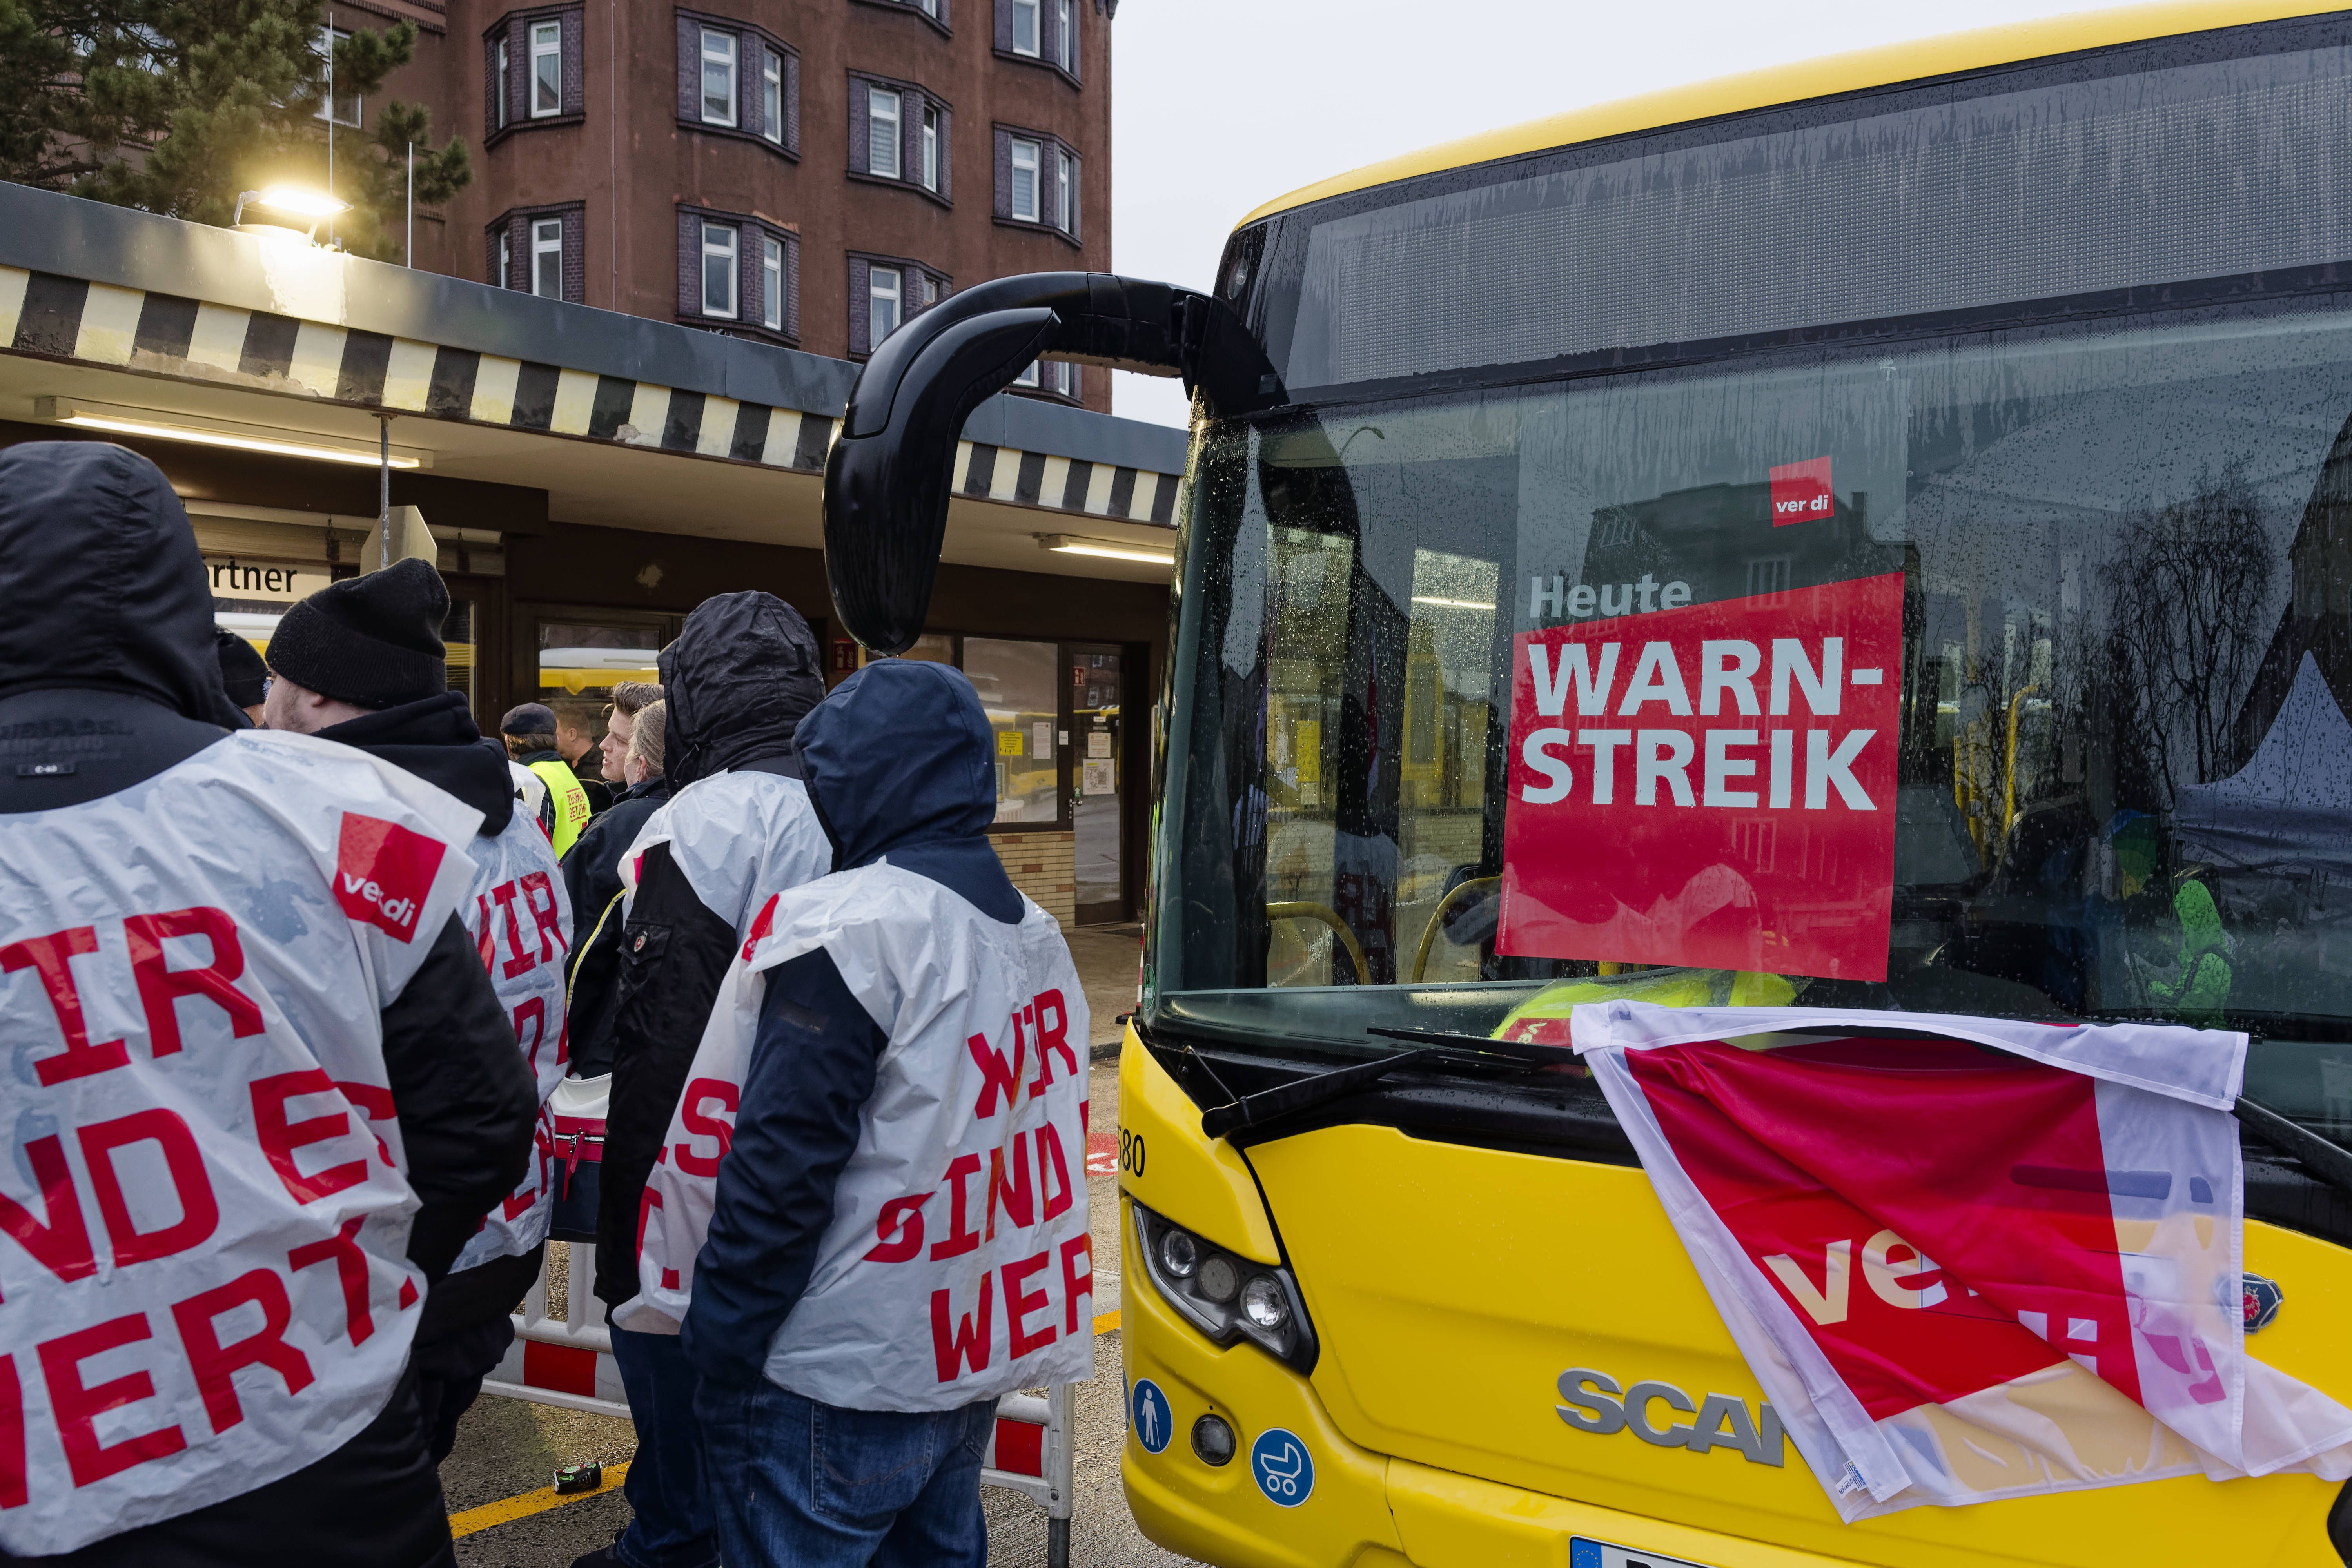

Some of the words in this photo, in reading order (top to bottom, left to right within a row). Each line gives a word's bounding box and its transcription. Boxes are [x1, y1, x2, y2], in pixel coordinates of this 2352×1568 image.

[201, 555, 297, 593] rtner
[1530, 573, 1692, 618] Heute
[1528, 637, 1883, 716] WARN-
[1522, 728, 1877, 810] STREIK
[862, 1121, 1073, 1263] SIND
